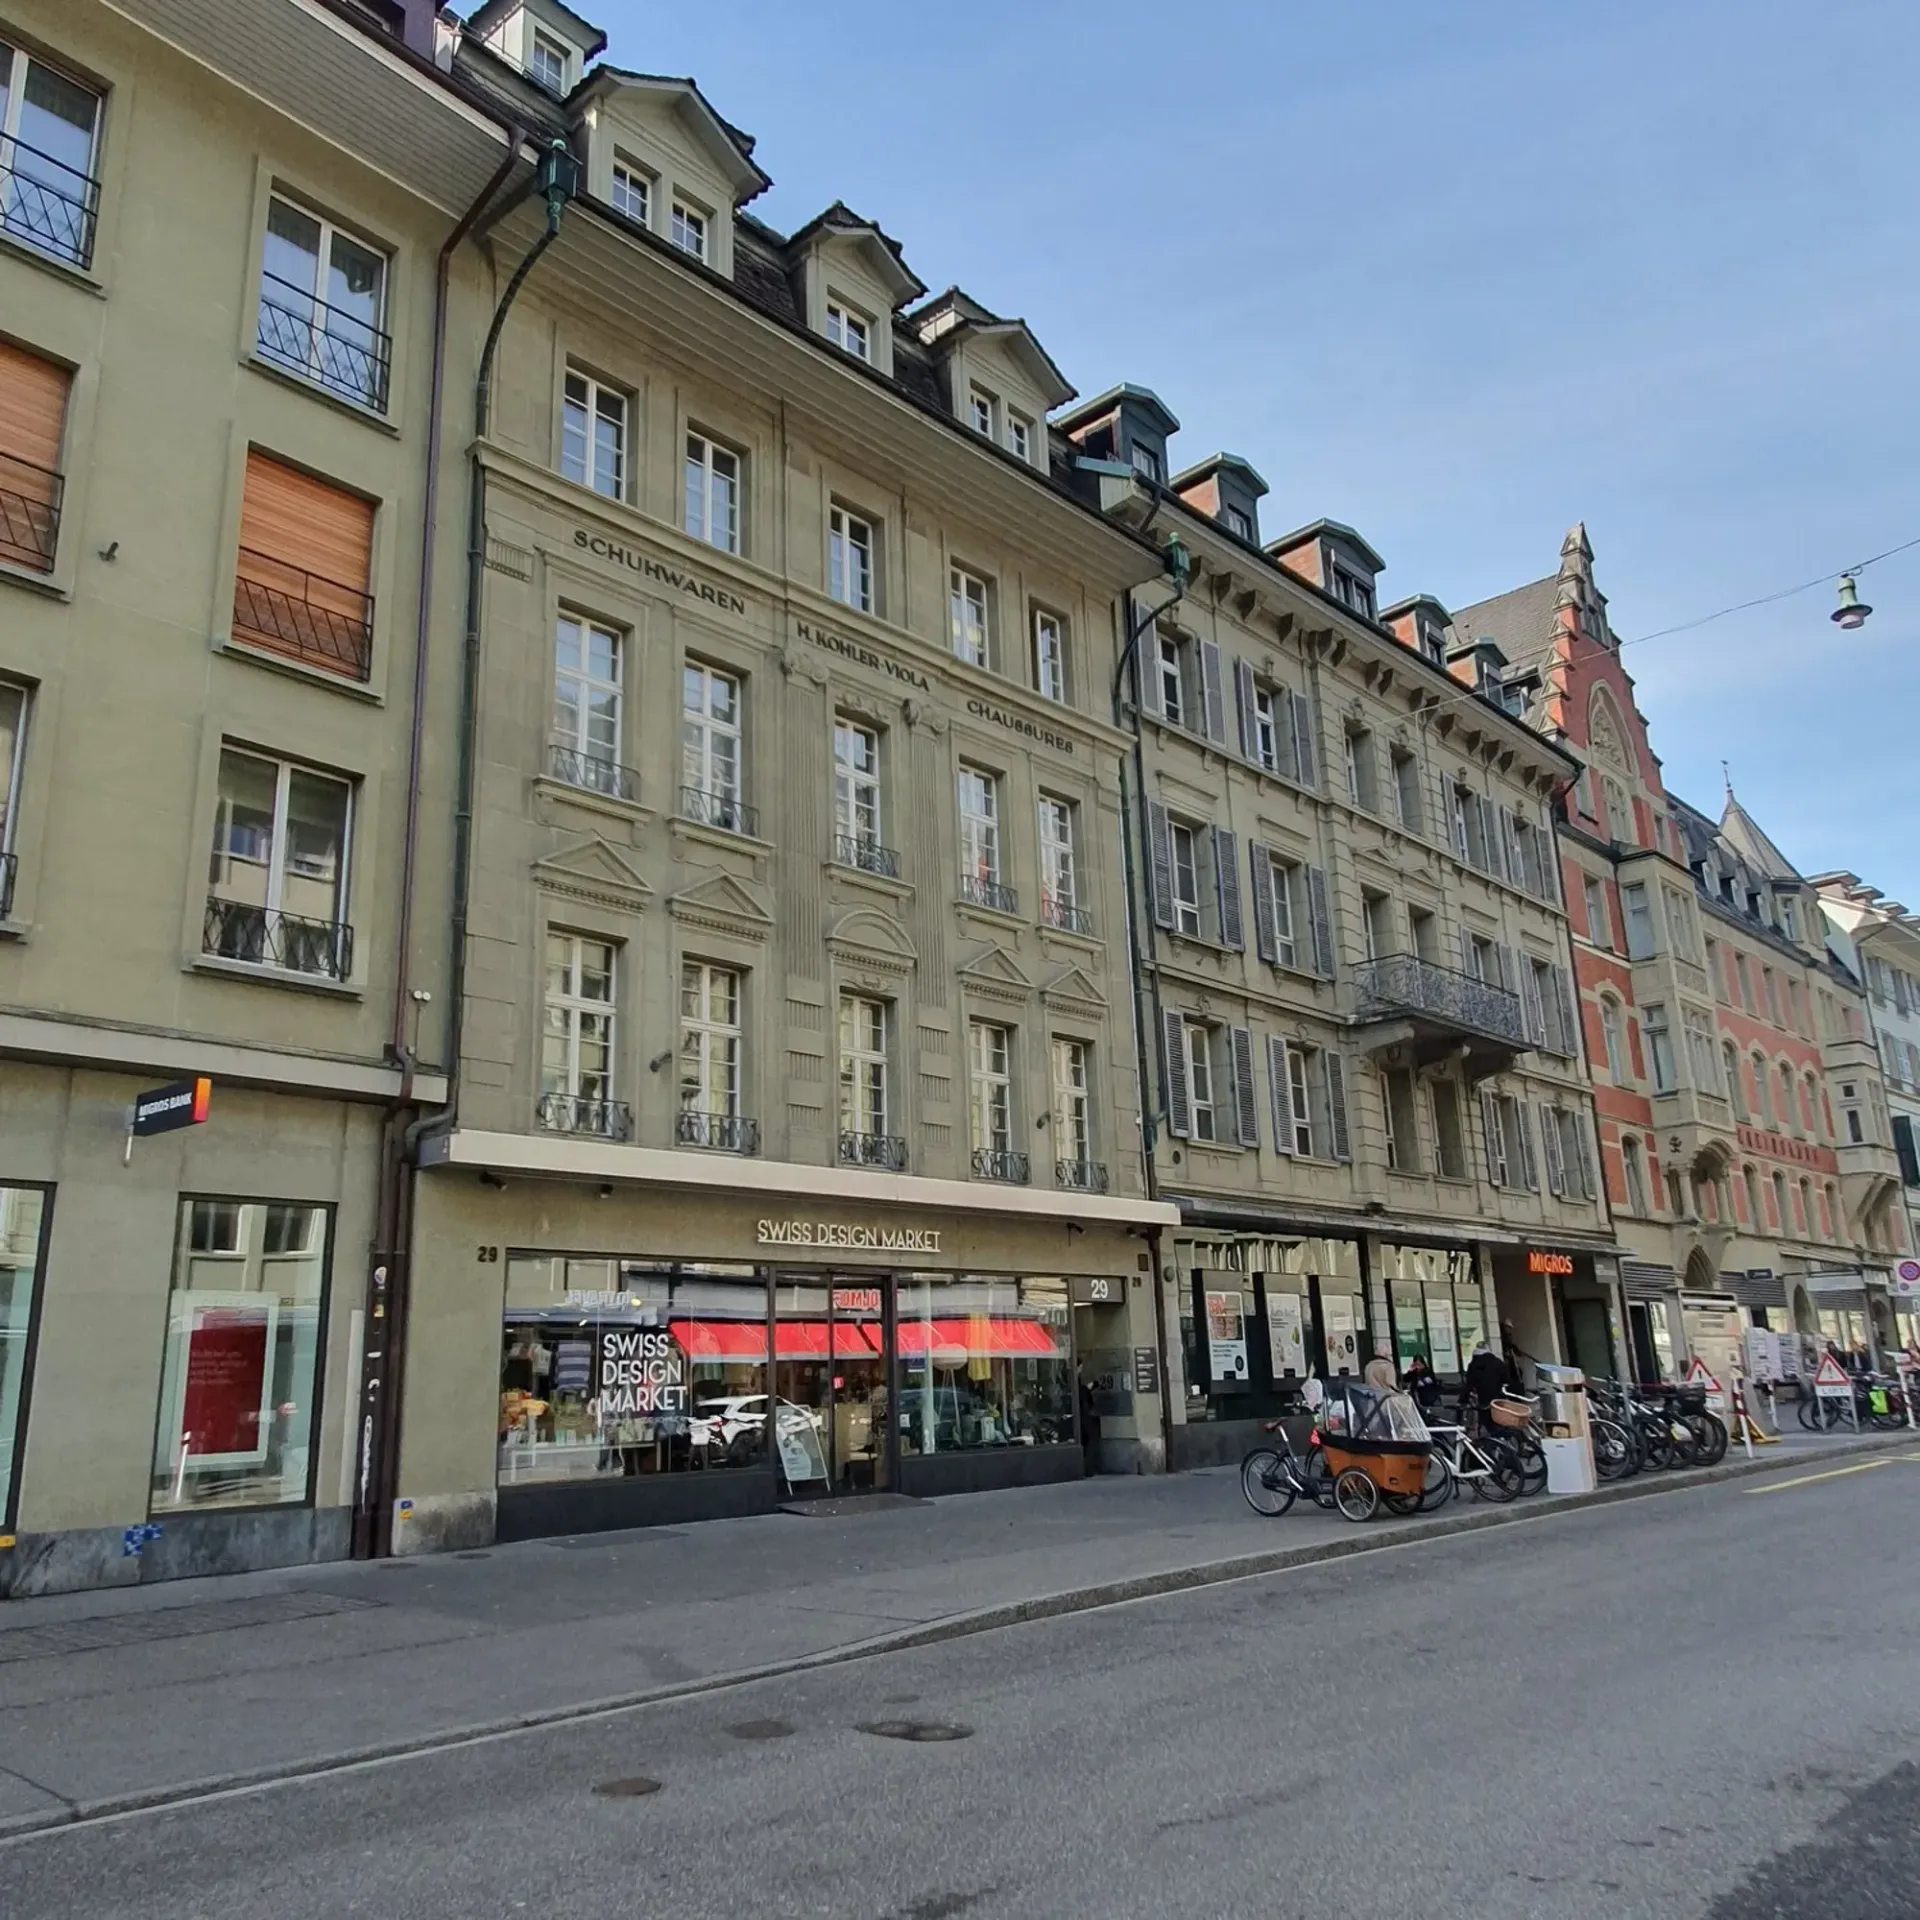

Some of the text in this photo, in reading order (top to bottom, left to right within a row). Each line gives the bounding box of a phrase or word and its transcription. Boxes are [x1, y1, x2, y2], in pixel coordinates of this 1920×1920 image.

[573, 529, 745, 615] SCHUHWAREN
[966, 699, 1074, 754] CHAUSSURES
[138, 1092, 193, 1116] MIGROS BANK
[757, 1218, 941, 1250] SWISS DESIGN MARKET
[477, 1245, 498, 1263] 29
[1528, 1251, 1574, 1274] MIGROS
[1090, 1279, 1109, 1299] 29
[603, 1333, 669, 1358] SWISS
[602, 1360, 682, 1385] DESIGN
[601, 1385, 688, 1413] MARKET
